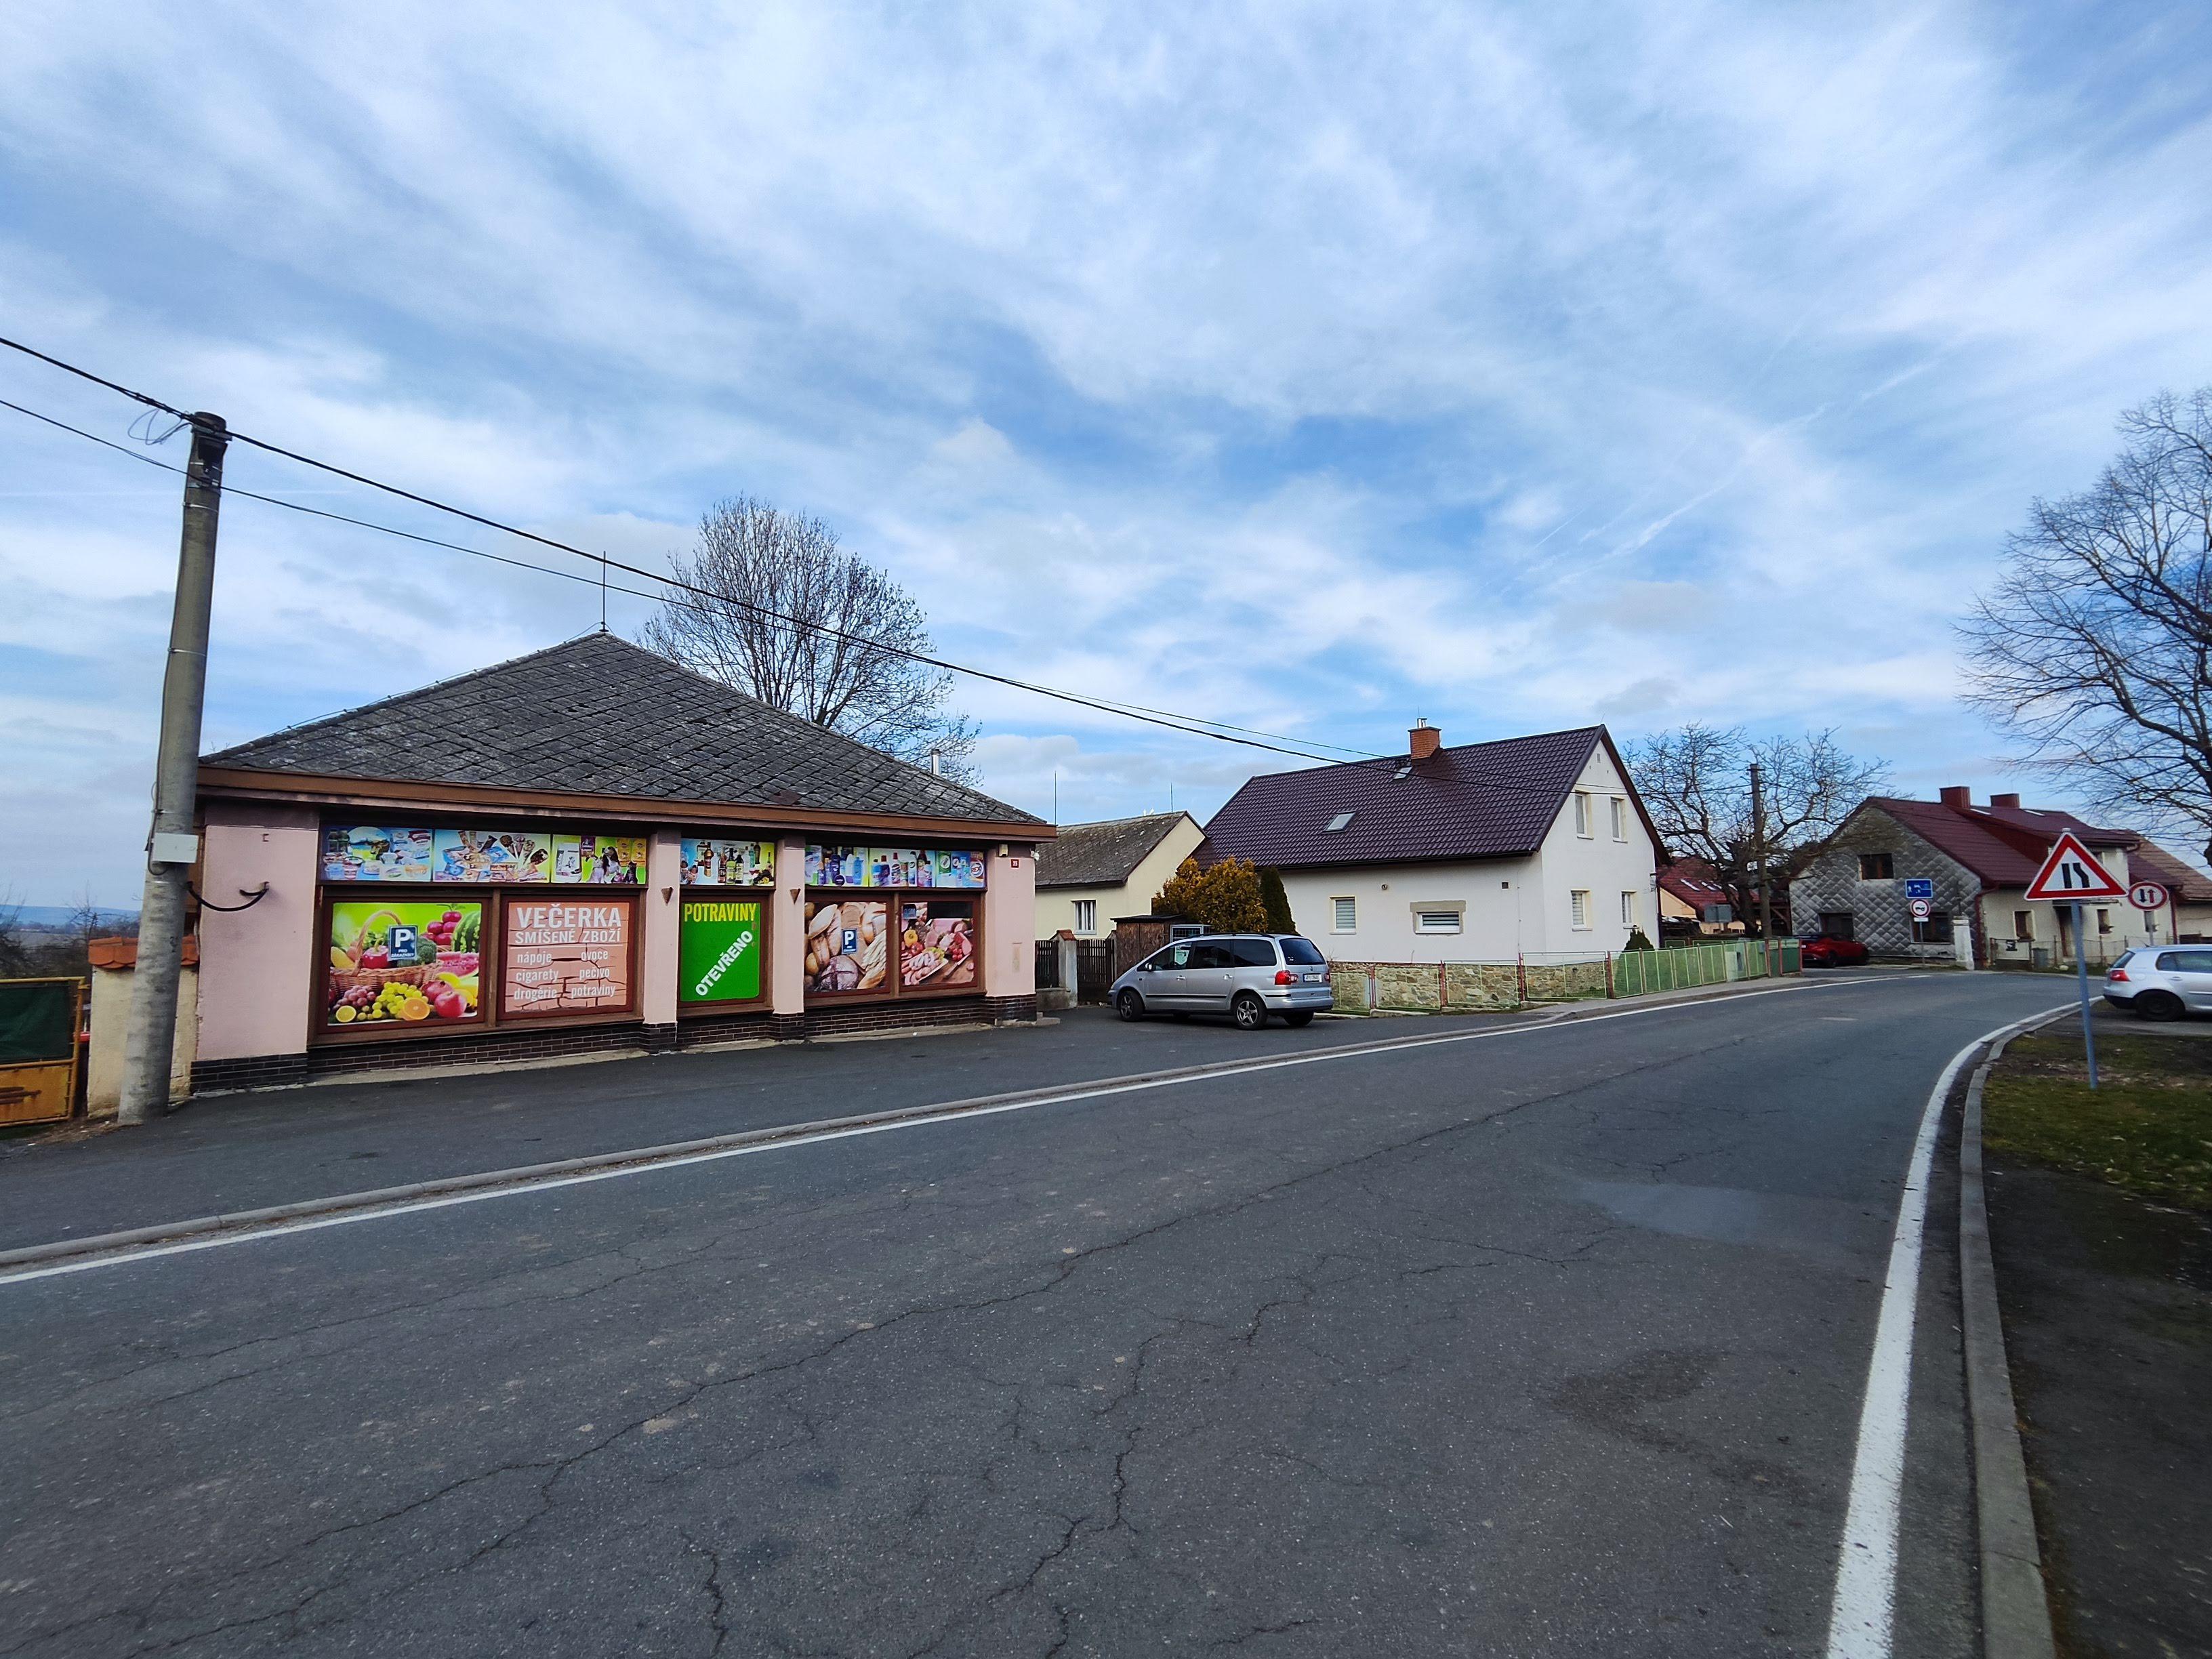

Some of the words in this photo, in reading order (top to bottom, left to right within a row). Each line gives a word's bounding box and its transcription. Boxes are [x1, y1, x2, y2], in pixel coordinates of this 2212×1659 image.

[516, 903, 621, 928] VEČERKA
[684, 903, 756, 922] POTRAVINY
[395, 929, 411, 947] P
[515, 928, 575, 944] SMÍŠENÉ
[582, 928, 621, 943] ZBOŽÍ
[844, 930, 854, 945] P
[517, 951, 552, 965] nápoje
[581, 950, 609, 961] ovoce
[695, 931, 753, 996] OTEVŘENO
[516, 970, 559, 983] cigarety
[579, 967, 610, 981] pečivo
[514, 987, 557, 1002] drogérie
[571, 985, 616, 998] potraviny
